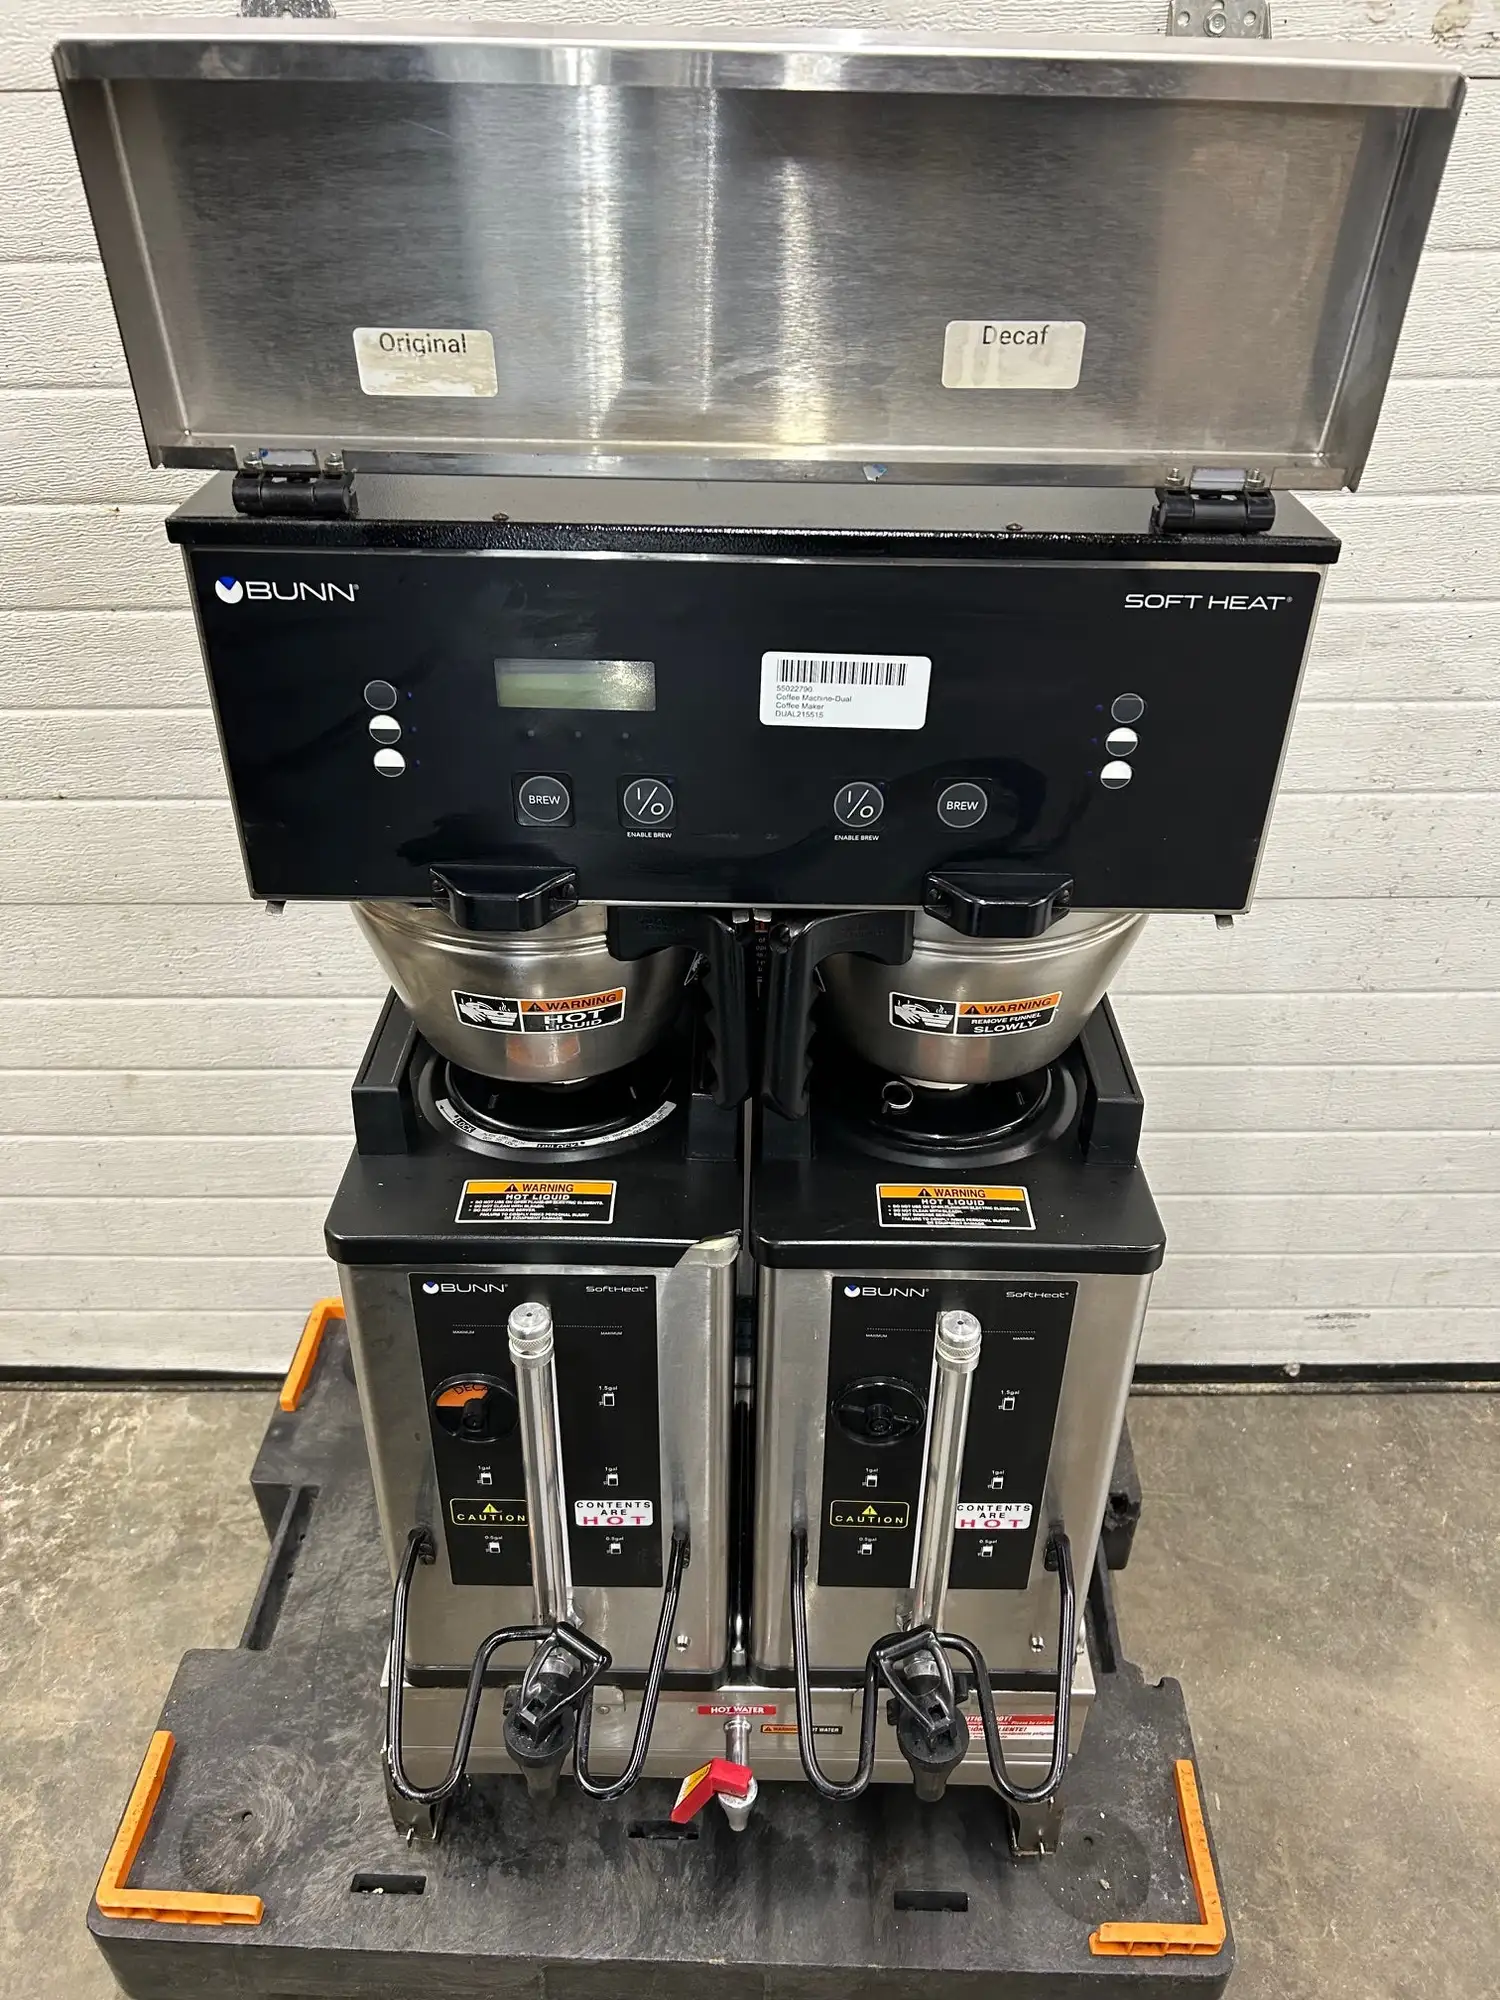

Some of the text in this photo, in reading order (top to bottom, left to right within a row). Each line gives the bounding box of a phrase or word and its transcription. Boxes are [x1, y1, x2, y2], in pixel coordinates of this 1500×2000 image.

[983, 324, 1050, 345] Decaf
[379, 332, 467, 356] Original
[245, 581, 355, 602] BUNN
[1124, 594, 1286, 610] SOFT HEAT
[776, 693, 852, 703] Coffee Machine-Dual
[775, 702, 825, 710] Coffee Maker
[528, 795, 561, 805] BREW
[946, 801, 979, 811] BREW
[546, 994, 617, 1012] WARNING
[984, 997, 1052, 1014] WARNING
[544, 1008, 605, 1025] HOT
[971, 1012, 1042, 1025] REMOVE FUNNEL
[545, 1019, 603, 1031] LIQUID
[973, 1019, 1038, 1034] SLOWLY
[454, 1117, 475, 1133] LOCK
[522, 1184, 574, 1193] WARNING
[934, 1188, 986, 1198] WARNING
[441, 1283, 505, 1293] BUNN
[586, 1285, 644, 1293] SoftHeat
[862, 1287, 926, 1297] BUNN
[1006, 1291, 1065, 1299] SoftHeat
[457, 1513, 526, 1521] CAUTION
[583, 1516, 646, 1525] HOT
[835, 1515, 903, 1523] CAUTION
[960, 1519, 1023, 1527] HOT
[710, 1706, 765, 1714] HOT WATER
